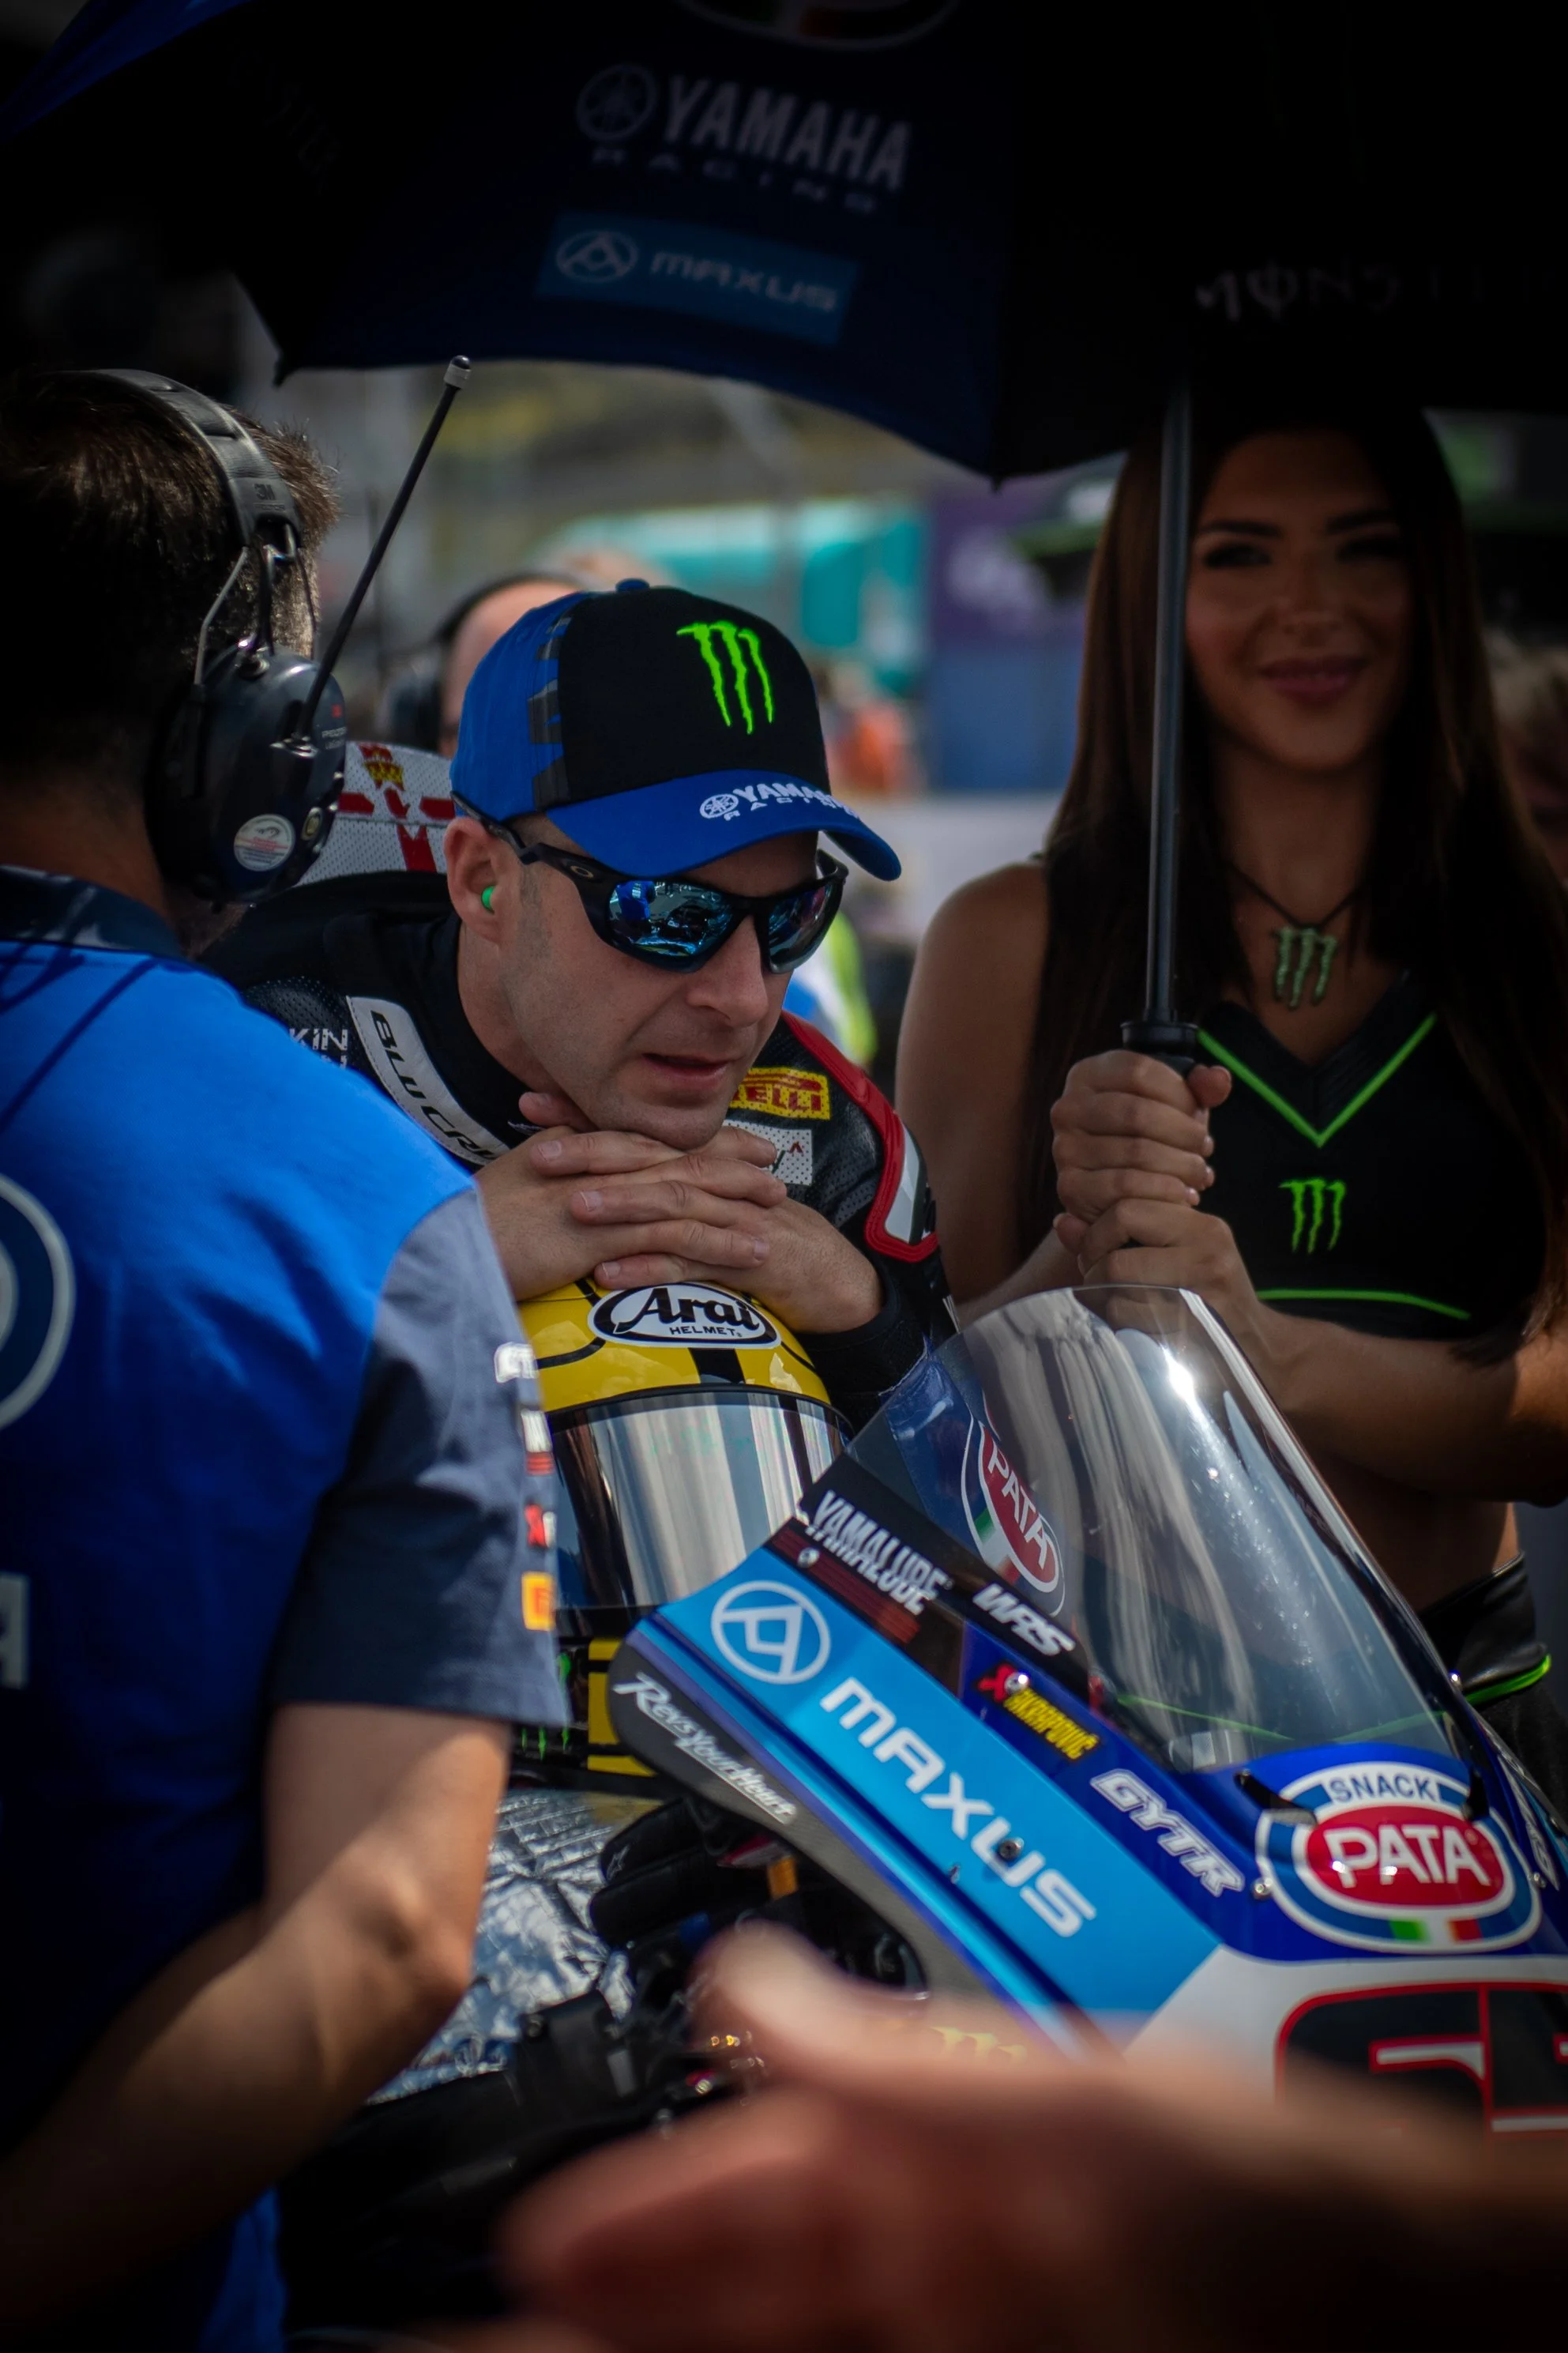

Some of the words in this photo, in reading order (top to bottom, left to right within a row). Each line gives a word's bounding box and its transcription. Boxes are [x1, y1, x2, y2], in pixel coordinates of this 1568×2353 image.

[662, 73, 913, 194] YAMAHA
[650, 250, 842, 313] MAXUS
[370, 1011, 427, 1099] BLU
[422, 1106, 499, 1160] CR
[614, 1287, 760, 1332] Arai
[670, 1325, 736, 1337] HELMET
[987, 1438, 1051, 1571] PATA
[819, 1677, 1097, 1939] MAXUS
[1089, 1768, 1246, 1897] GYTR
[1329, 1772, 1441, 1805] SNACK
[1322, 1822, 1491, 1891] PATA
